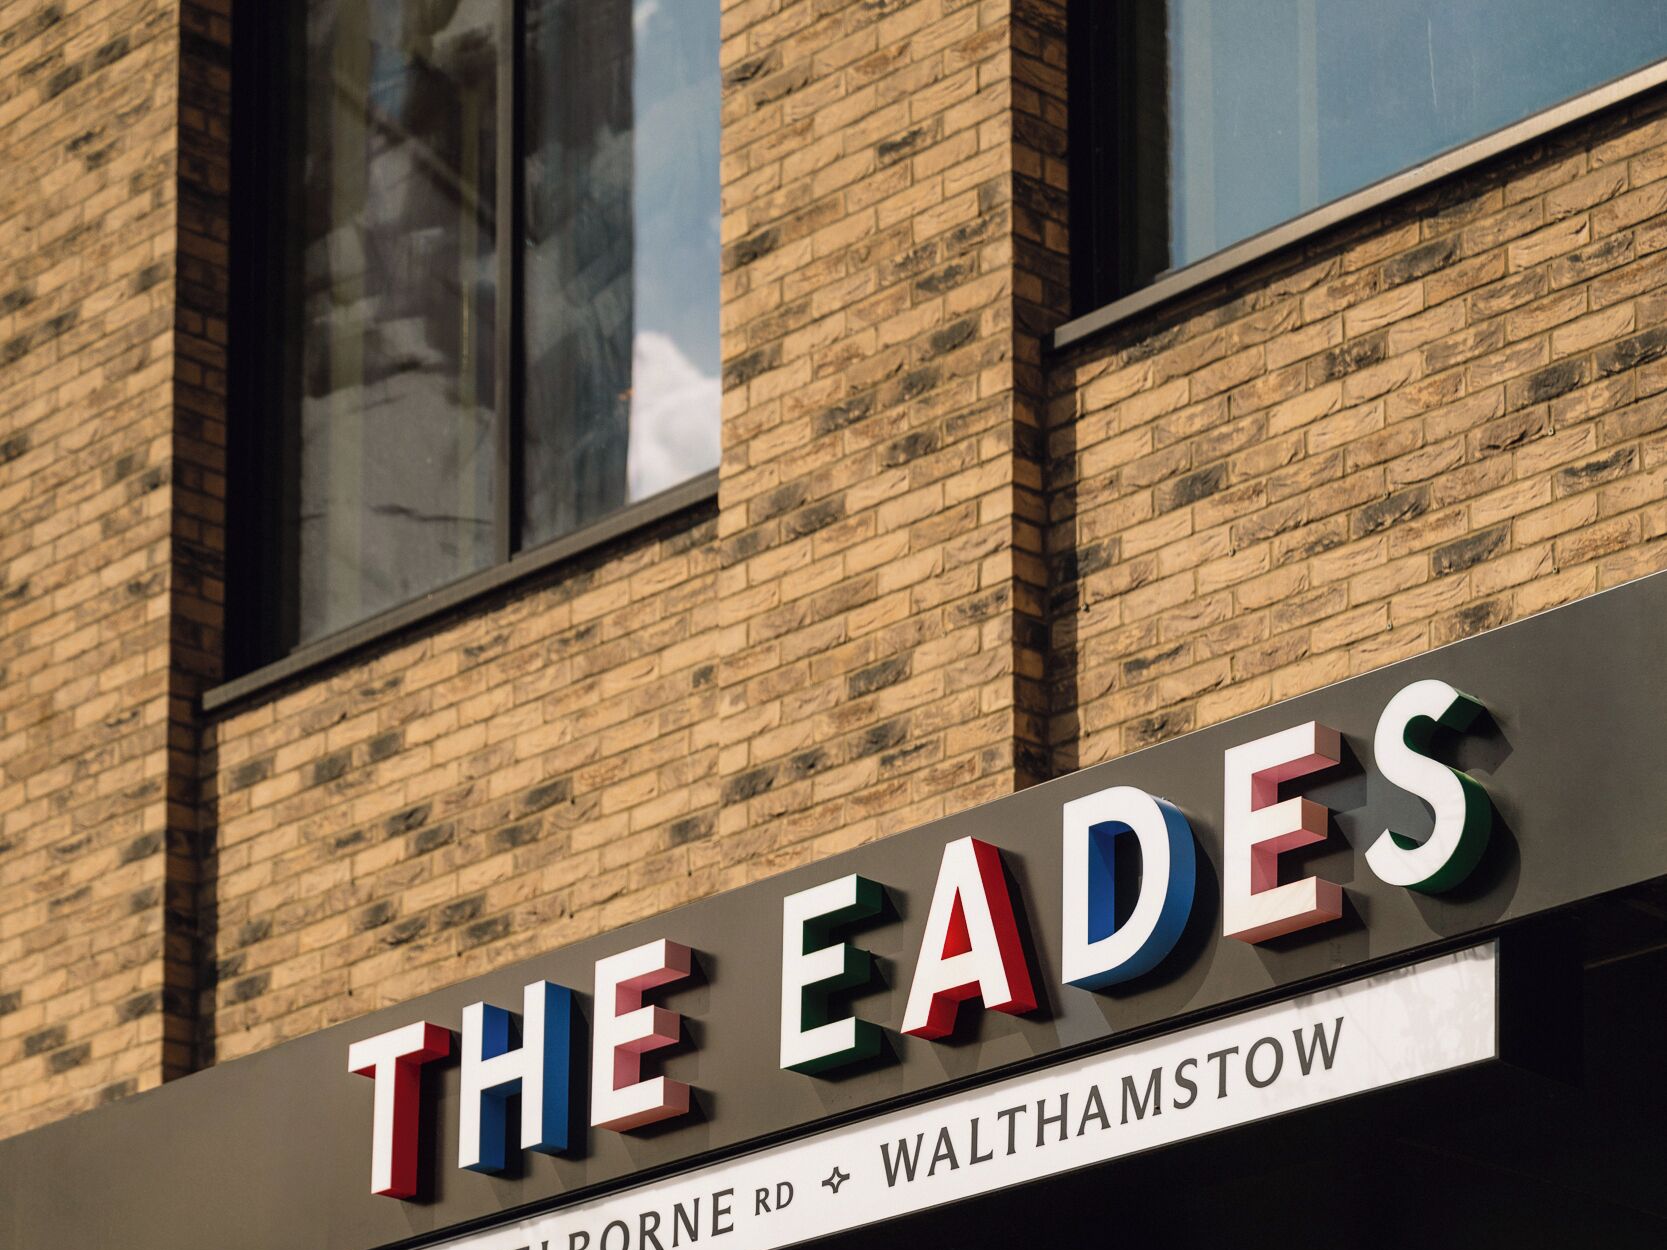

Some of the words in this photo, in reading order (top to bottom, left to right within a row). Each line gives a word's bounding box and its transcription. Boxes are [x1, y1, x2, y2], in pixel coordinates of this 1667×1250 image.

[347, 938, 691, 1198] THE
[779, 679, 1491, 1074] EADES
[754, 1181, 795, 1217] RD
[879, 1016, 1344, 1188] WALTHAMSTOW
